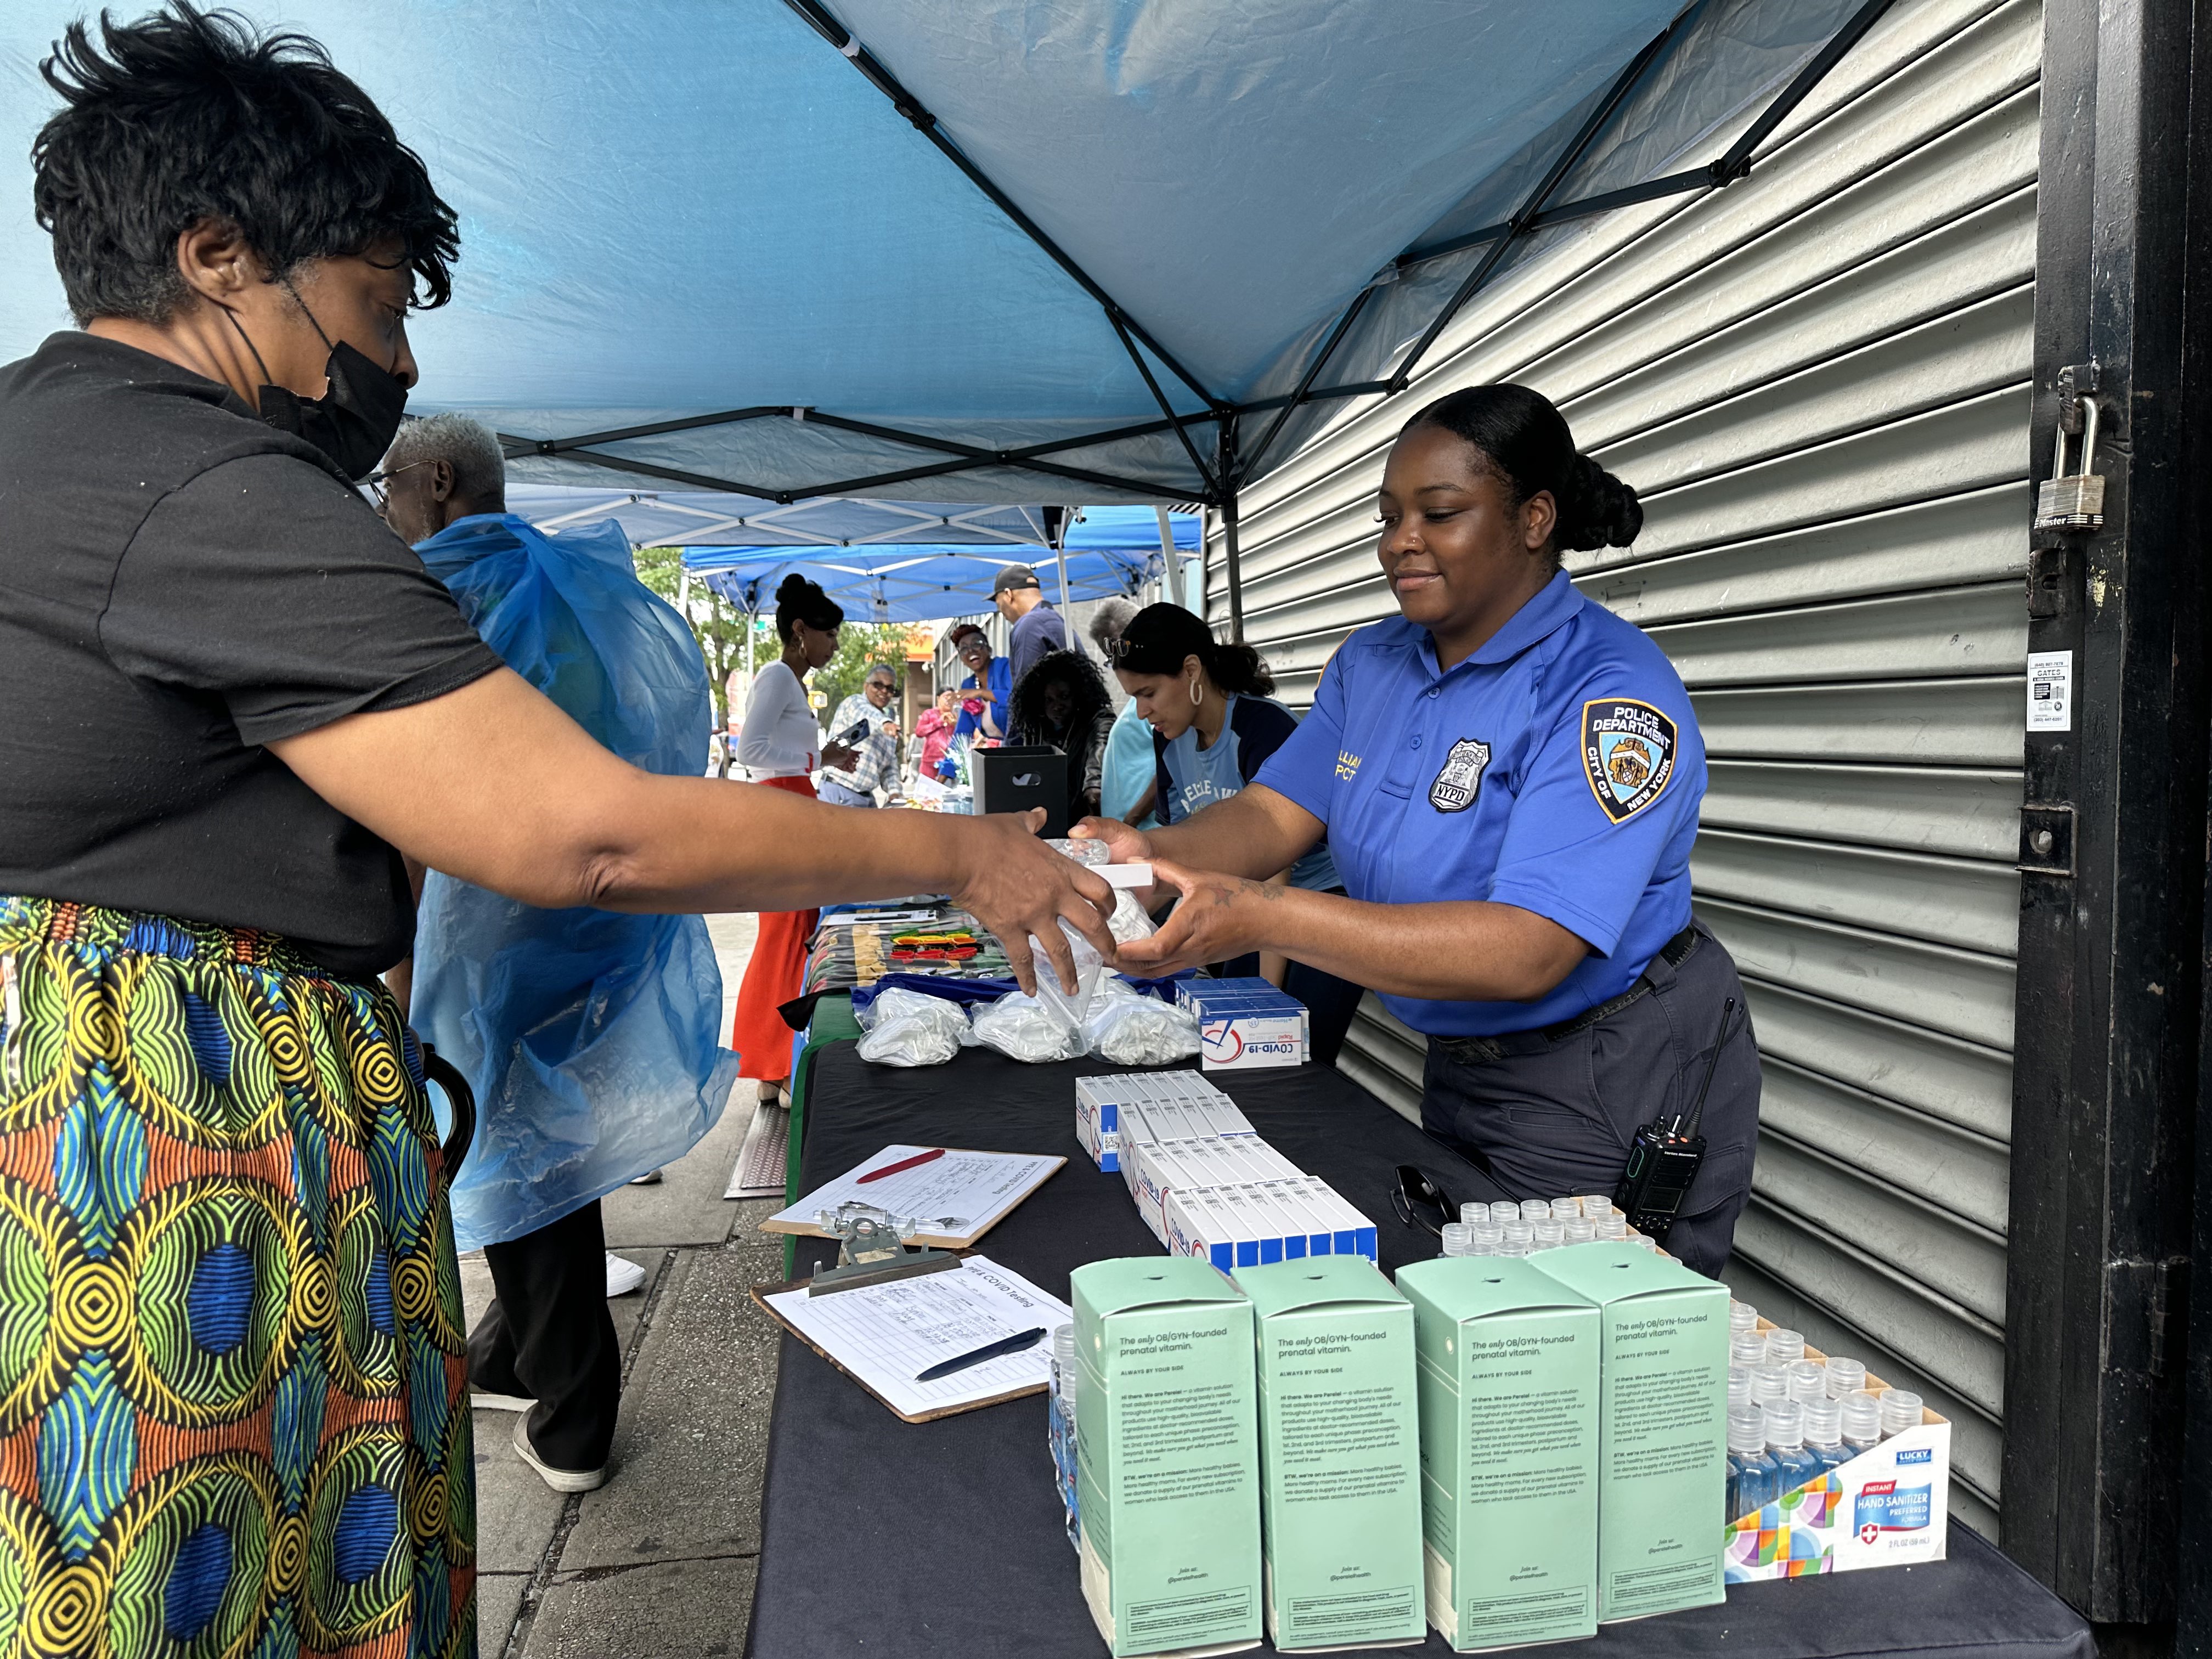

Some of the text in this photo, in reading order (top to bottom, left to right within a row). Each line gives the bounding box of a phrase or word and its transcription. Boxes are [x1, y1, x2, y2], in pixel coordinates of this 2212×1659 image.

[2039, 517, 2066, 527] Master
[1613, 707, 1659, 729] POLICE
[1593, 719, 1671, 749] DEPARTMENT
[1335, 764, 1356, 782] PCT
[1588, 746, 1612, 799] CITY OF
[1627, 758, 1671, 811] NEW YORK
[1436, 785, 1465, 802] NYPD
[983, 1275, 1010, 1291] COVID
[1006, 1288, 1034, 1308] Testing
[1615, 1313, 1707, 1331] The only OB/GYN-founded
[1119, 1328, 1227, 1345] The only OB/GYN-founded
[1277, 1330, 1386, 1347] The only OB/GYN-founded
[1472, 1334, 1575, 1350] The only OB/GYN-founded
[1615, 1328, 1678, 1342] prenatal vitamin.
[1120, 1341, 1192, 1357] prenatal vitamin.
[1278, 1344, 1352, 1359] prenatal vitamin.
[1472, 1347, 1541, 1361] prenatal vitamin.
[1899, 1451, 1928, 1460] LUCKY
[1865, 1483, 1892, 1492] INSTANT
[1858, 1493, 1928, 1510] HAND SANITIZER
[1889, 1506, 1927, 1516] PREFERRED
